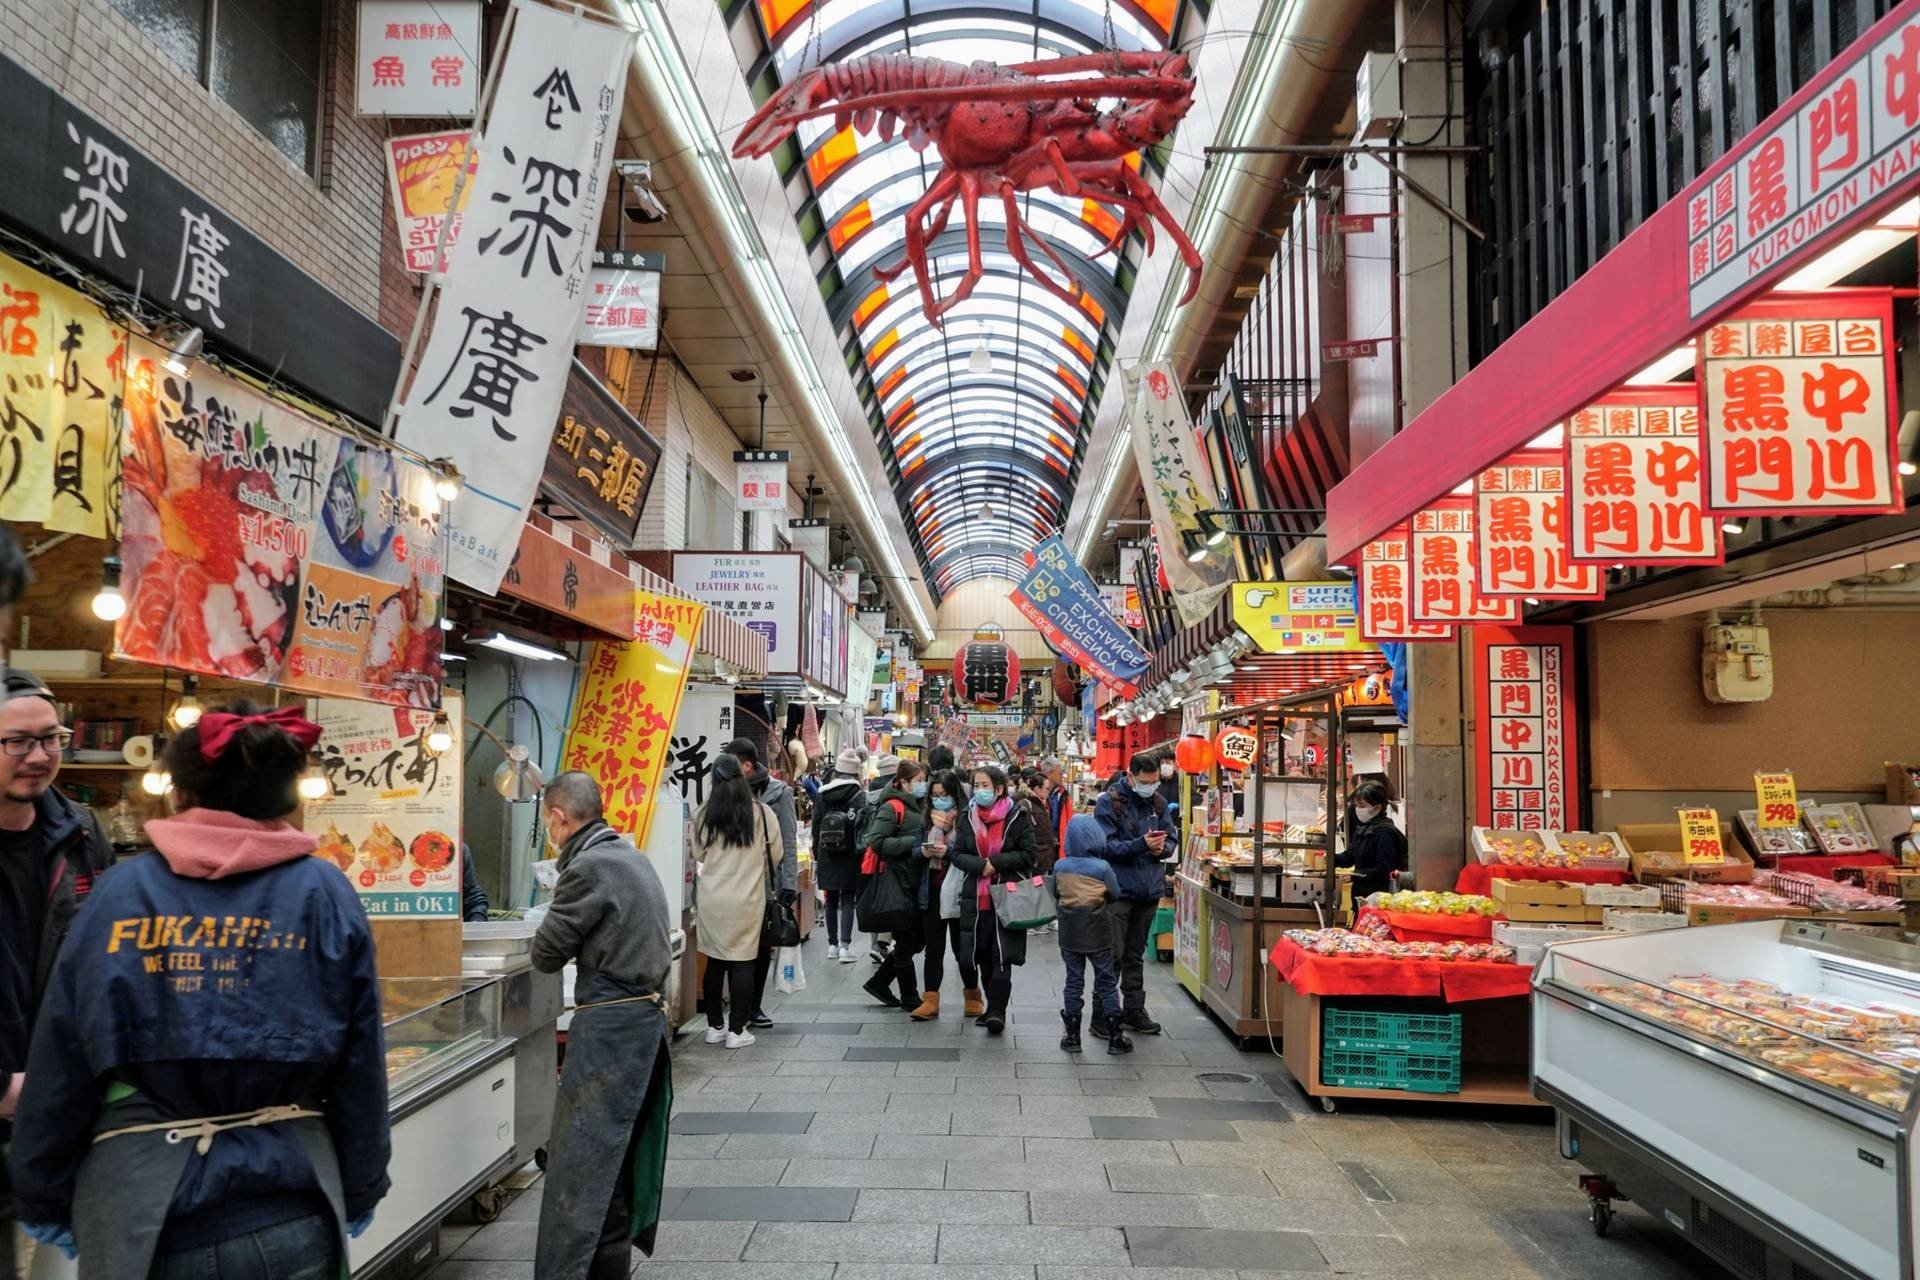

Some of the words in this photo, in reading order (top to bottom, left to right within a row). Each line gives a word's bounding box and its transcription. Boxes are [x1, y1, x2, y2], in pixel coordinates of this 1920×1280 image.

[385, 23, 453, 41] 高級鮮魚
[372, 56, 464, 87] 魚常
[396, 140, 449, 164] クロモン
[60, 121, 231, 328] 深廣
[1747, 185, 1858, 277] KUROMON
[423, 146, 582, 442] 深廣
[585, 304, 648, 328] 三都屋
[1711, 322, 1877, 356] 生鮮屋台
[238, 482, 286, 515] Sashimi
[287, 500, 308, 524] Don
[237, 510, 308, 561] ¥1,500
[714, 558, 732, 567] FUR
[695, 582, 740, 592] LEATHER
[745, 582, 765, 592] BAG
[710, 570, 751, 580] JEWELRY
[1545, 648, 1558, 730] KUROMON
[719, 706, 731, 730] 黒門
[1500, 648, 1534, 786] 黒門中川
[1547, 735, 1561, 830] NAKAGAWA
[1765, 803, 1796, 821] 598
[1690, 839, 1721, 858] 598
[361, 897, 388, 913] Eat
[393, 896, 410, 913] in
[142, 954, 165, 974] WE
[168, 952, 205, 971] FEEL
